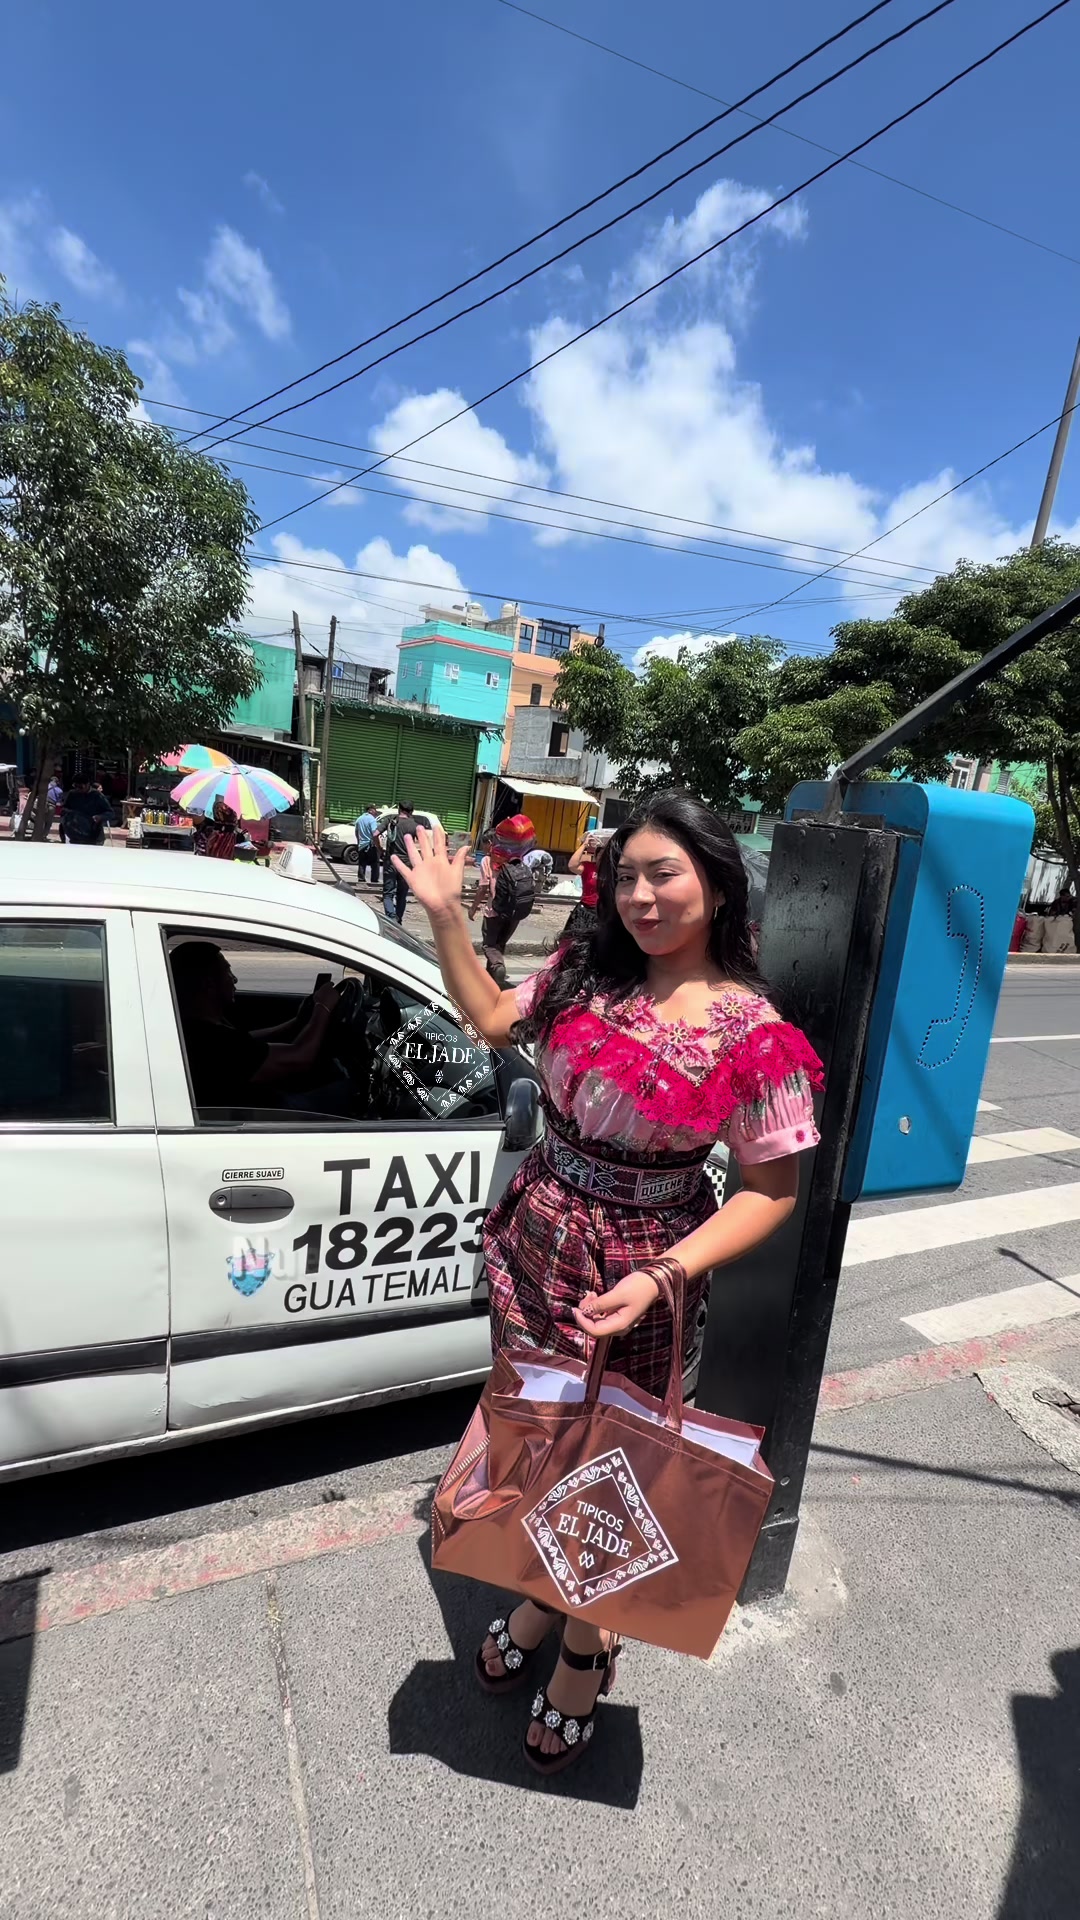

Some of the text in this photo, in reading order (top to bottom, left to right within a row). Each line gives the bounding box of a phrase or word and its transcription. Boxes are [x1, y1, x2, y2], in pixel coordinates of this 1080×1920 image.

[225, 1170, 282, 1179] CIERRE SUAVE
[323, 1150, 480, 1216] TAXI
[642, 1175, 684, 1198] QUICHE
[292, 1208, 491, 1275] 18223
[556, 1512, 633, 1559] EL JADE
[577, 1500, 624, 1532] TIPICOS
